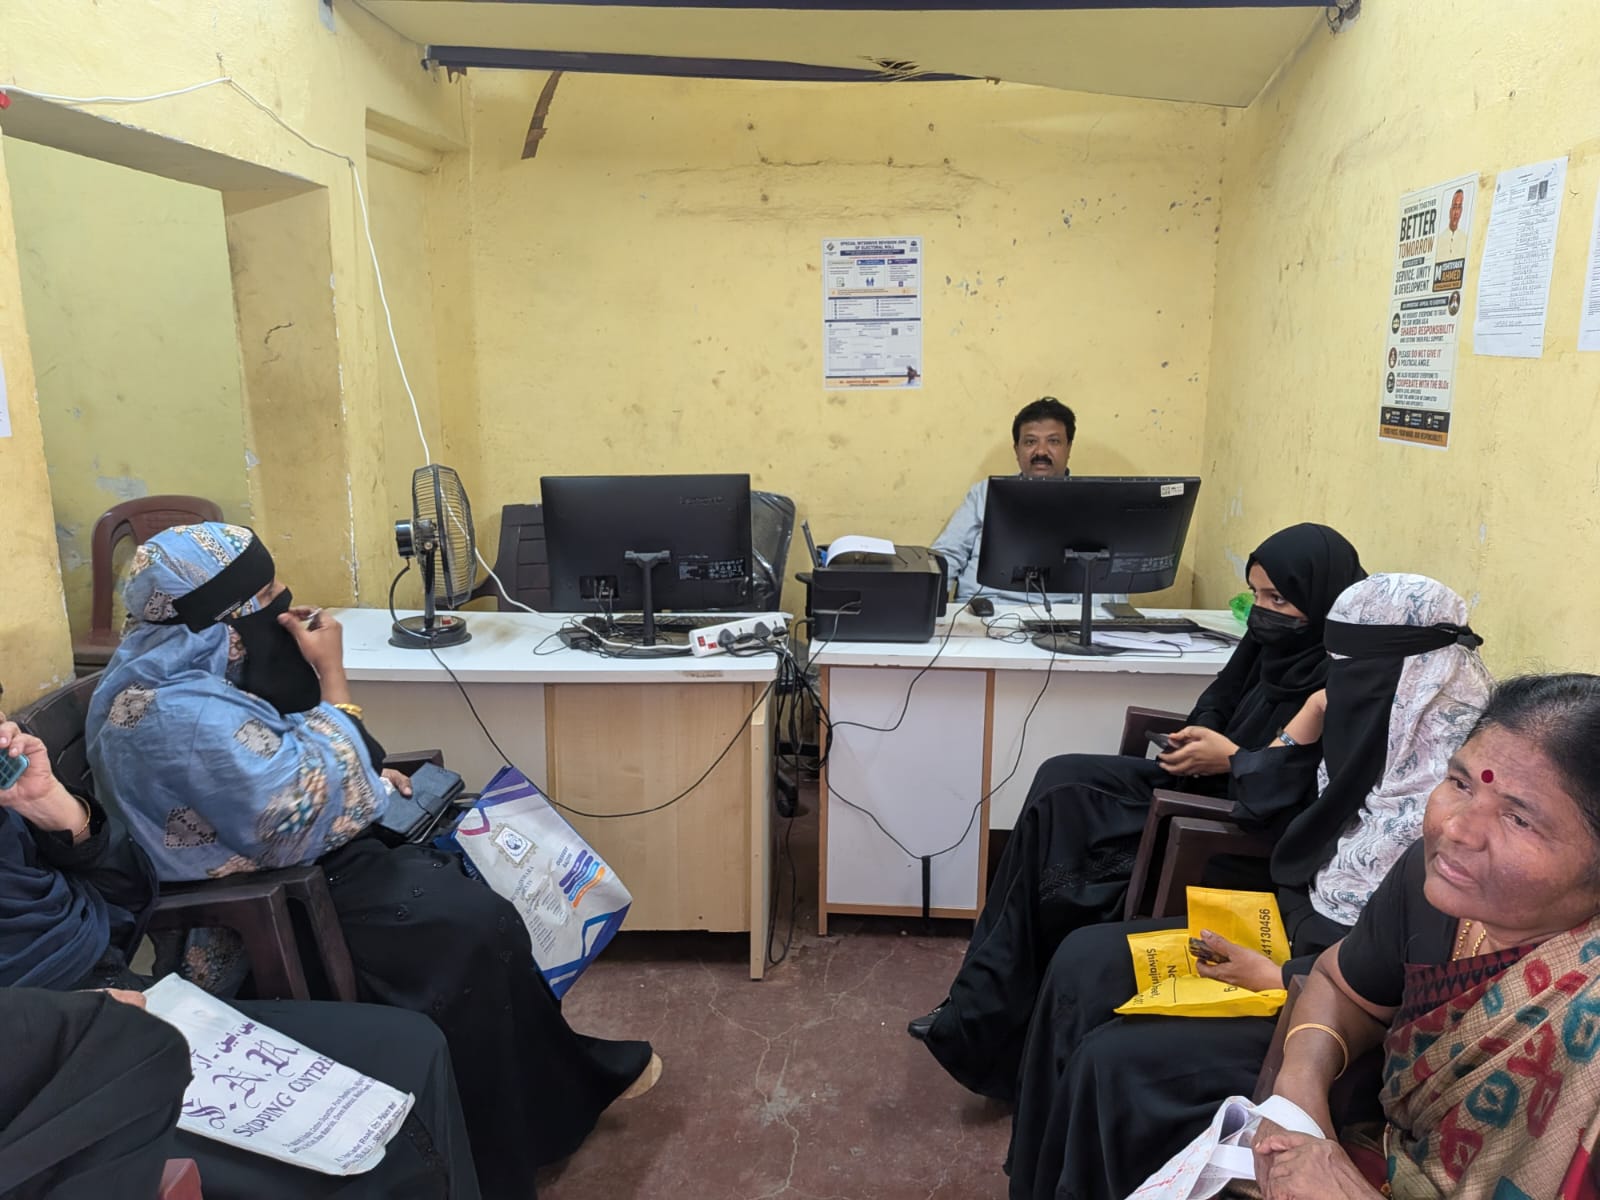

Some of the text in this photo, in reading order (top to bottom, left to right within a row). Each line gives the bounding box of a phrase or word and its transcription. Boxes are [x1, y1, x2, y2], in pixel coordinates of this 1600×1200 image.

[1400, 208, 1437, 242] BETTER
[1399, 236, 1435, 259] TOMORROW
[1399, 280, 1430, 294] DEVELOPMENT
[1400, 326, 1417, 337] SHARED
